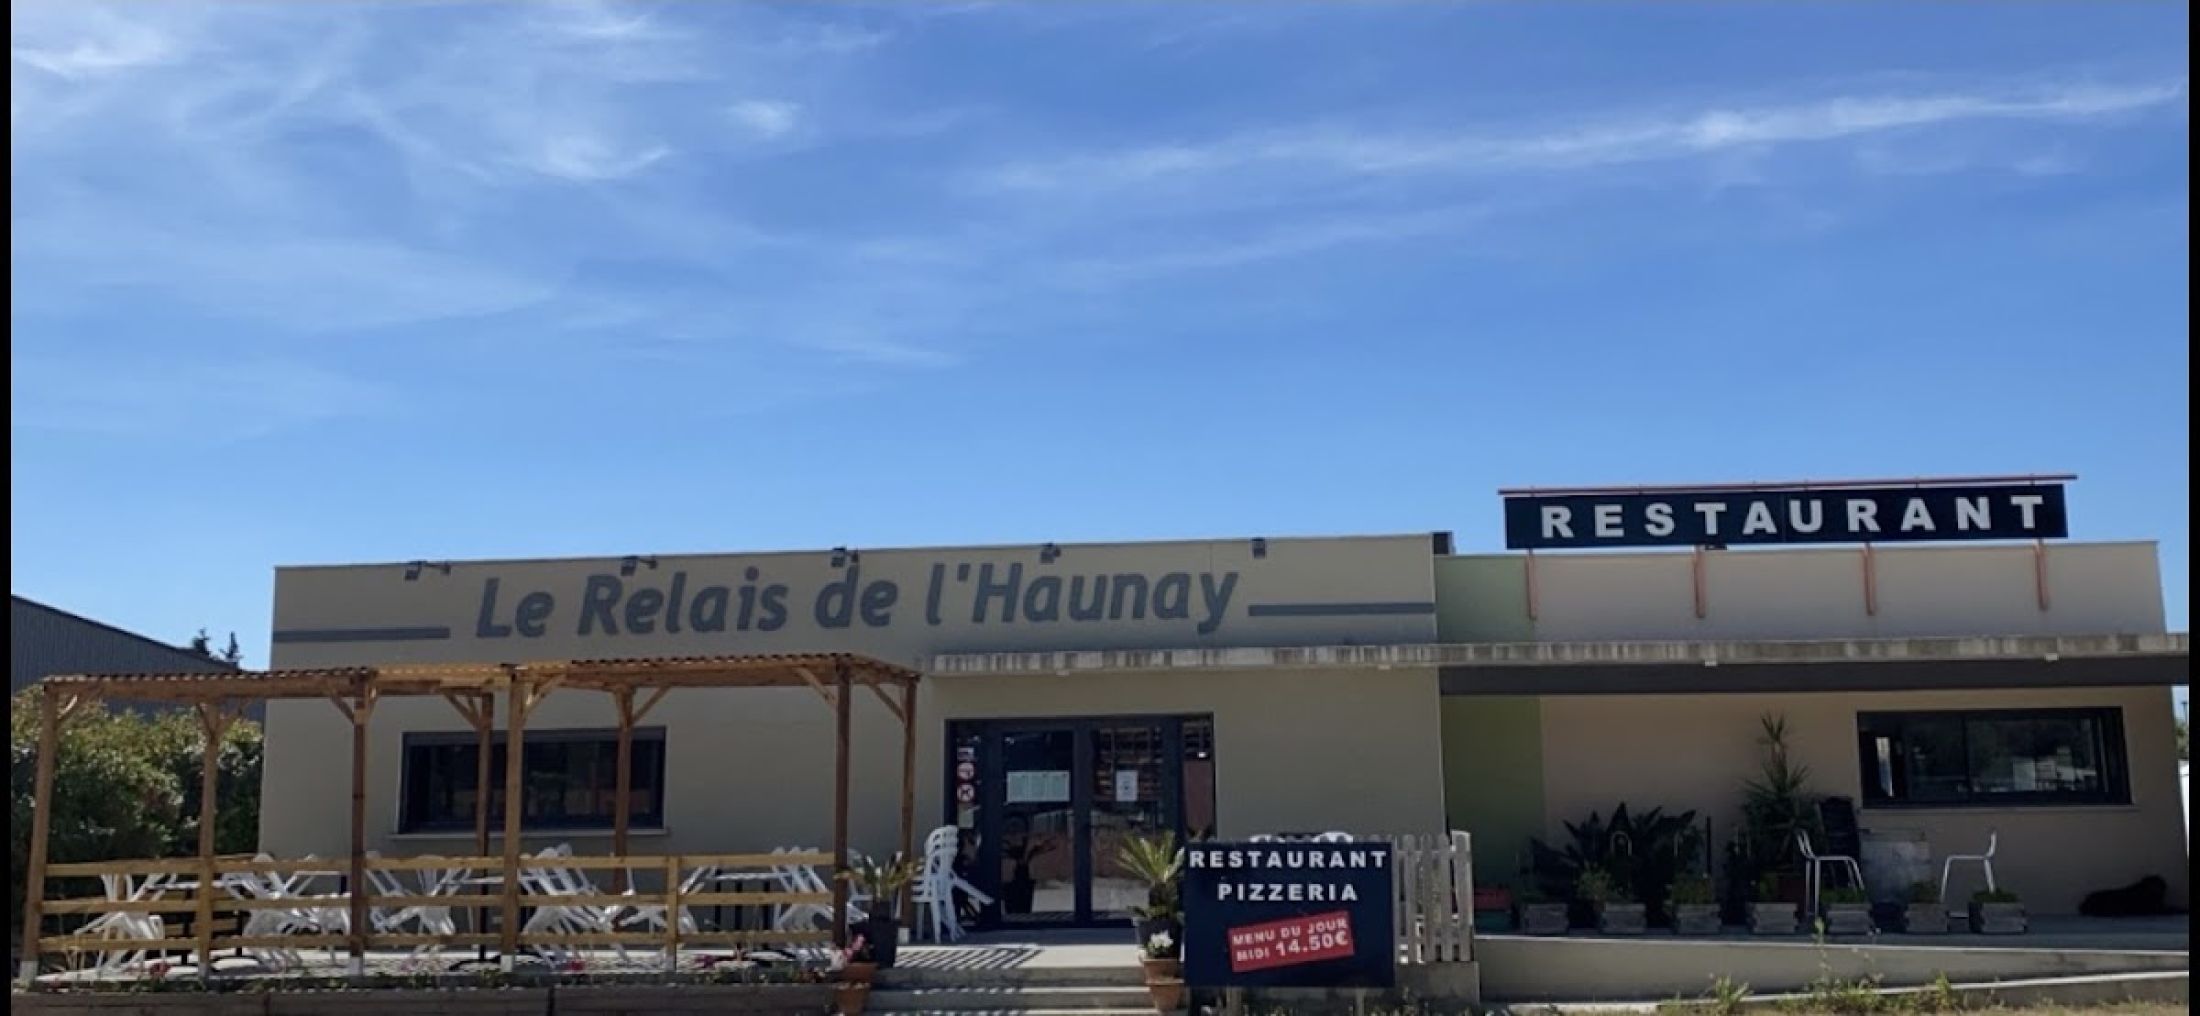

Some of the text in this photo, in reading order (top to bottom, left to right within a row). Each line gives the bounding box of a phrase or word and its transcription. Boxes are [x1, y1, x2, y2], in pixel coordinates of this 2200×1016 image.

[1540, 495, 2044, 539] RESTAURANT
[476, 562, 1239, 639] Le Relais de l'Haunay
[1189, 850, 1387, 868] RESTAURANT
[1217, 883, 1358, 901] PIZZERIA
[1232, 917, 1348, 946] MENU DU JOUR
[1236, 930, 1349, 962] MIDI 14.50€
